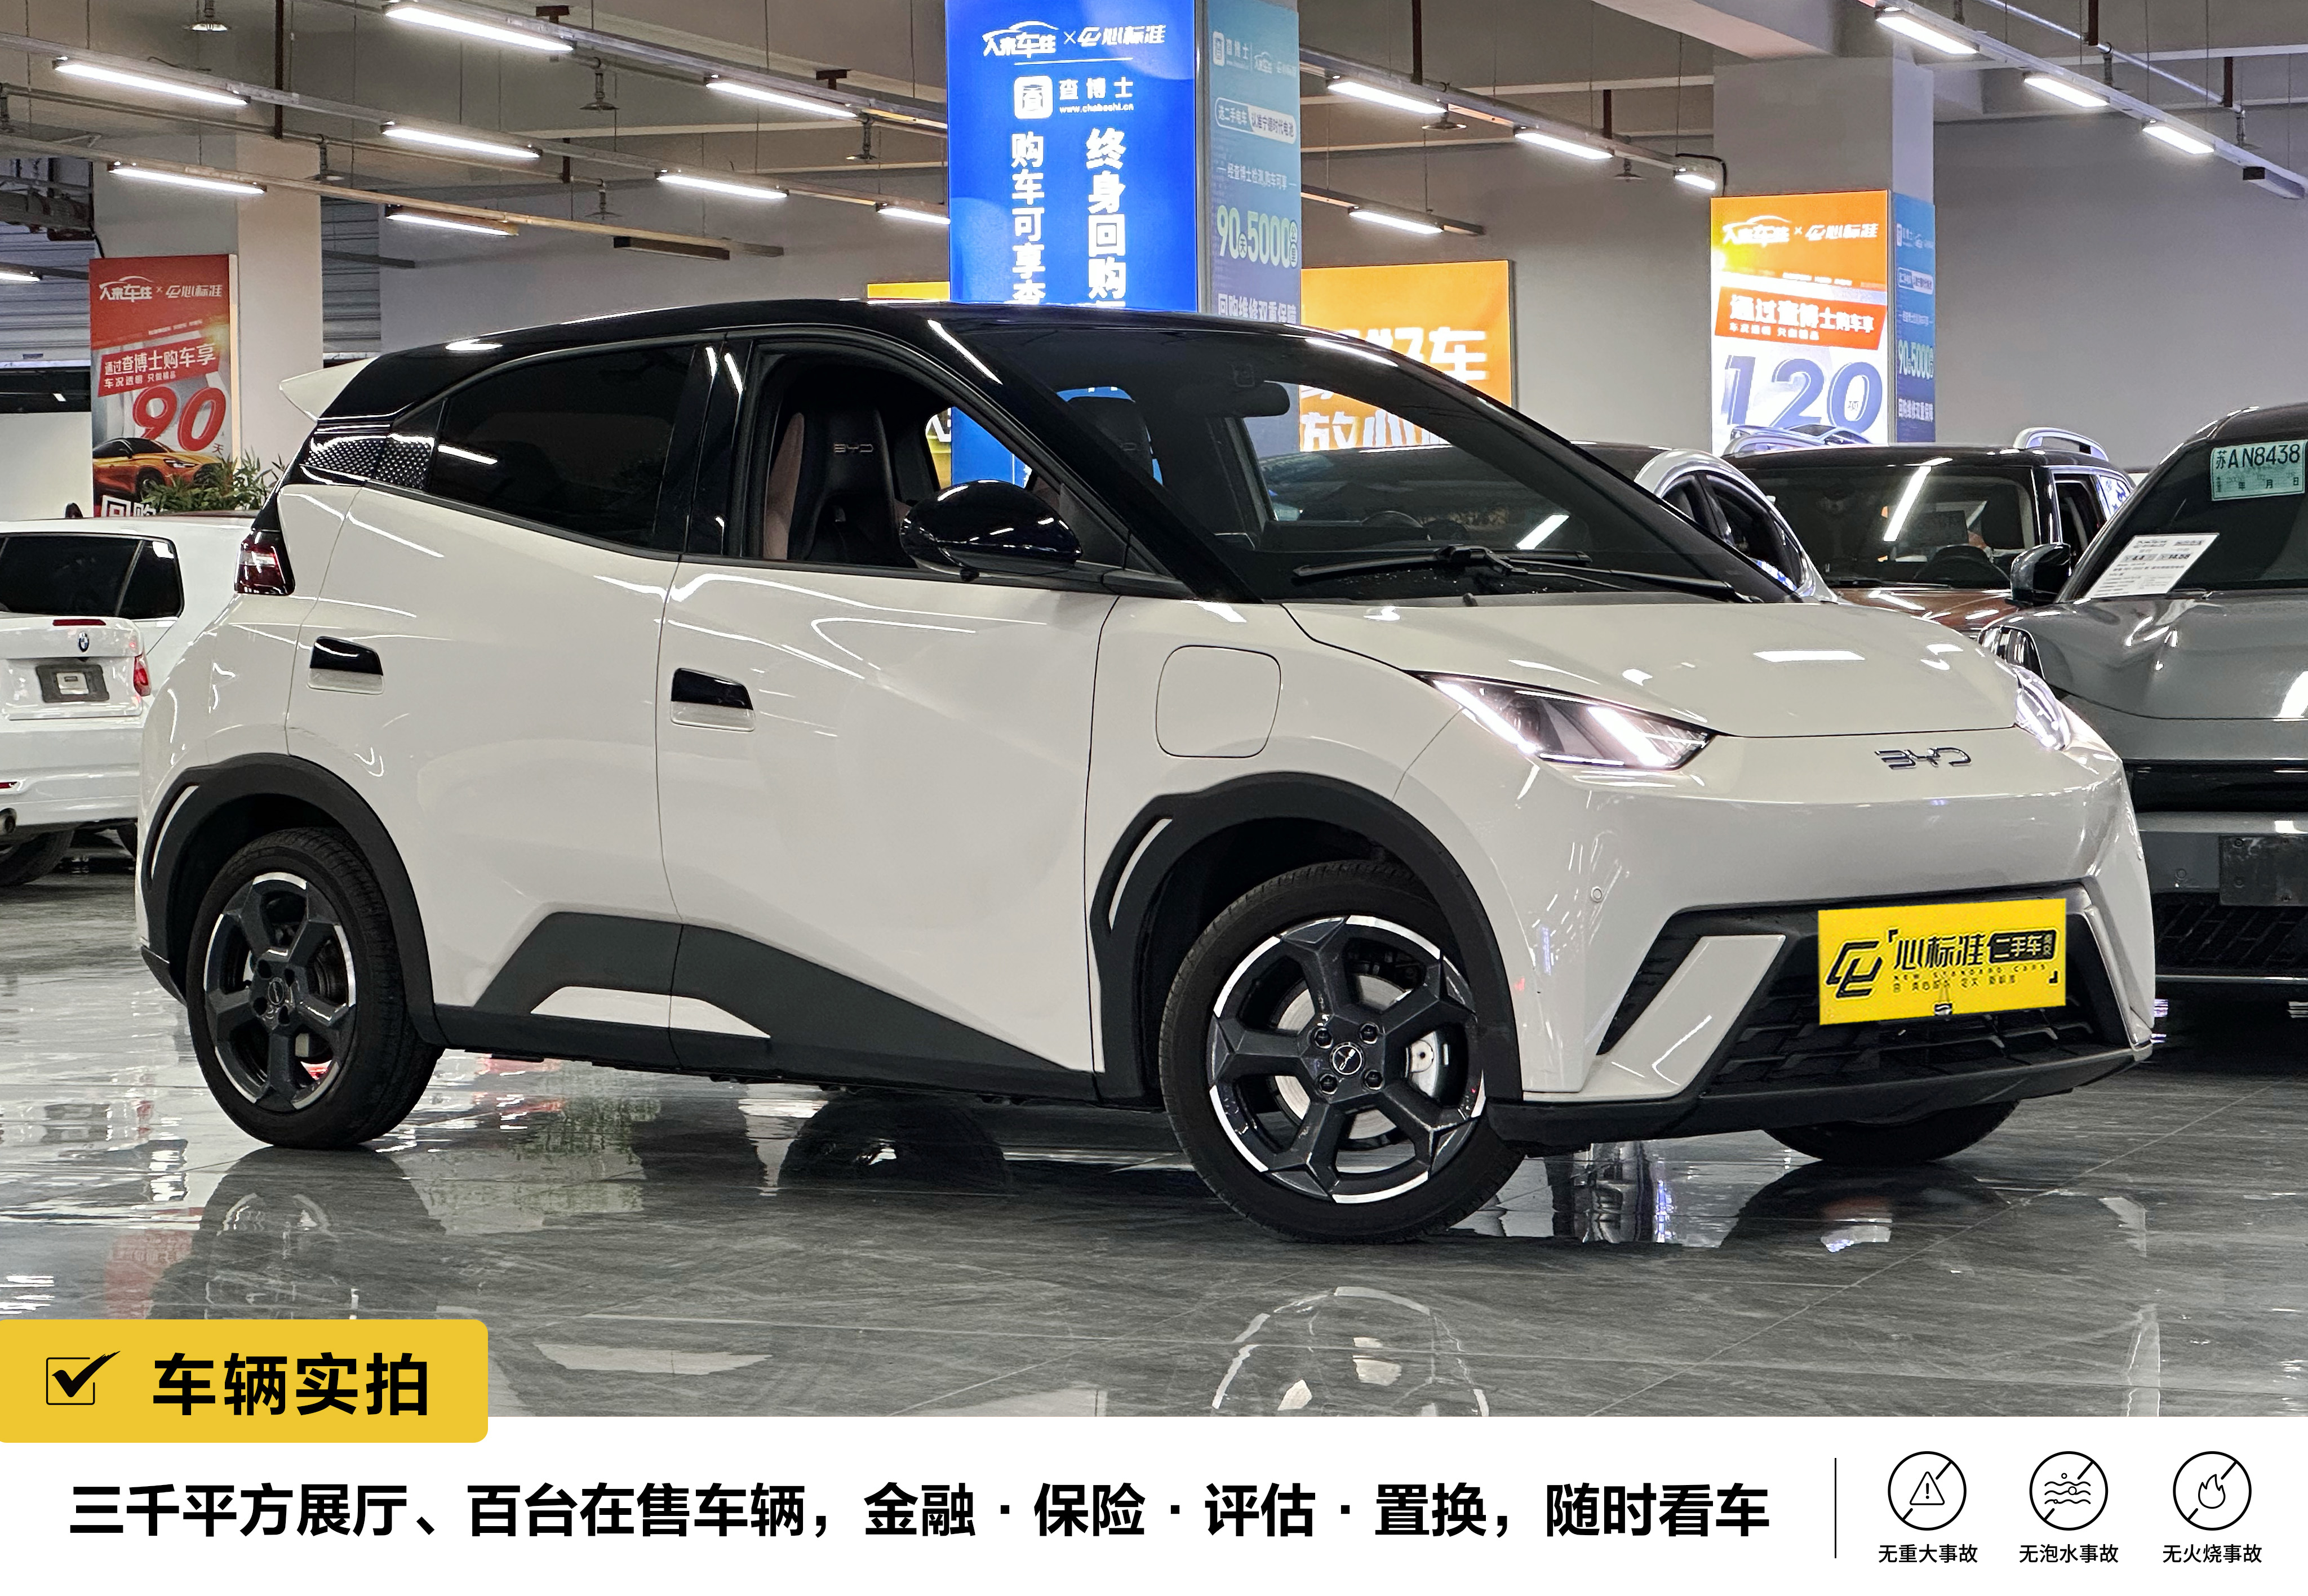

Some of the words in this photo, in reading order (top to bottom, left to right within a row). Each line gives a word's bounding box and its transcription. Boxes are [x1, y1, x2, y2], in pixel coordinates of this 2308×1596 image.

[1102, 25, 1166, 45] 心标准
[1058, 76, 1134, 100] 查博士
[180, 284, 223, 298] 心标准
[105, 343, 216, 376] 通过查博士购车享
[1721, 354, 1883, 436] 120
[132, 386, 226, 451] 90
[833, 443, 874, 453] BYD
[2216, 443, 2301, 469] 苏AN8438
[2265, 479, 2273, 489] 月
[2293, 477, 2299, 486] 日
[1874, 746, 1972, 770] BYD
[1893, 933, 1986, 971] 心标准
[1994, 935, 2043, 957] 二手车
